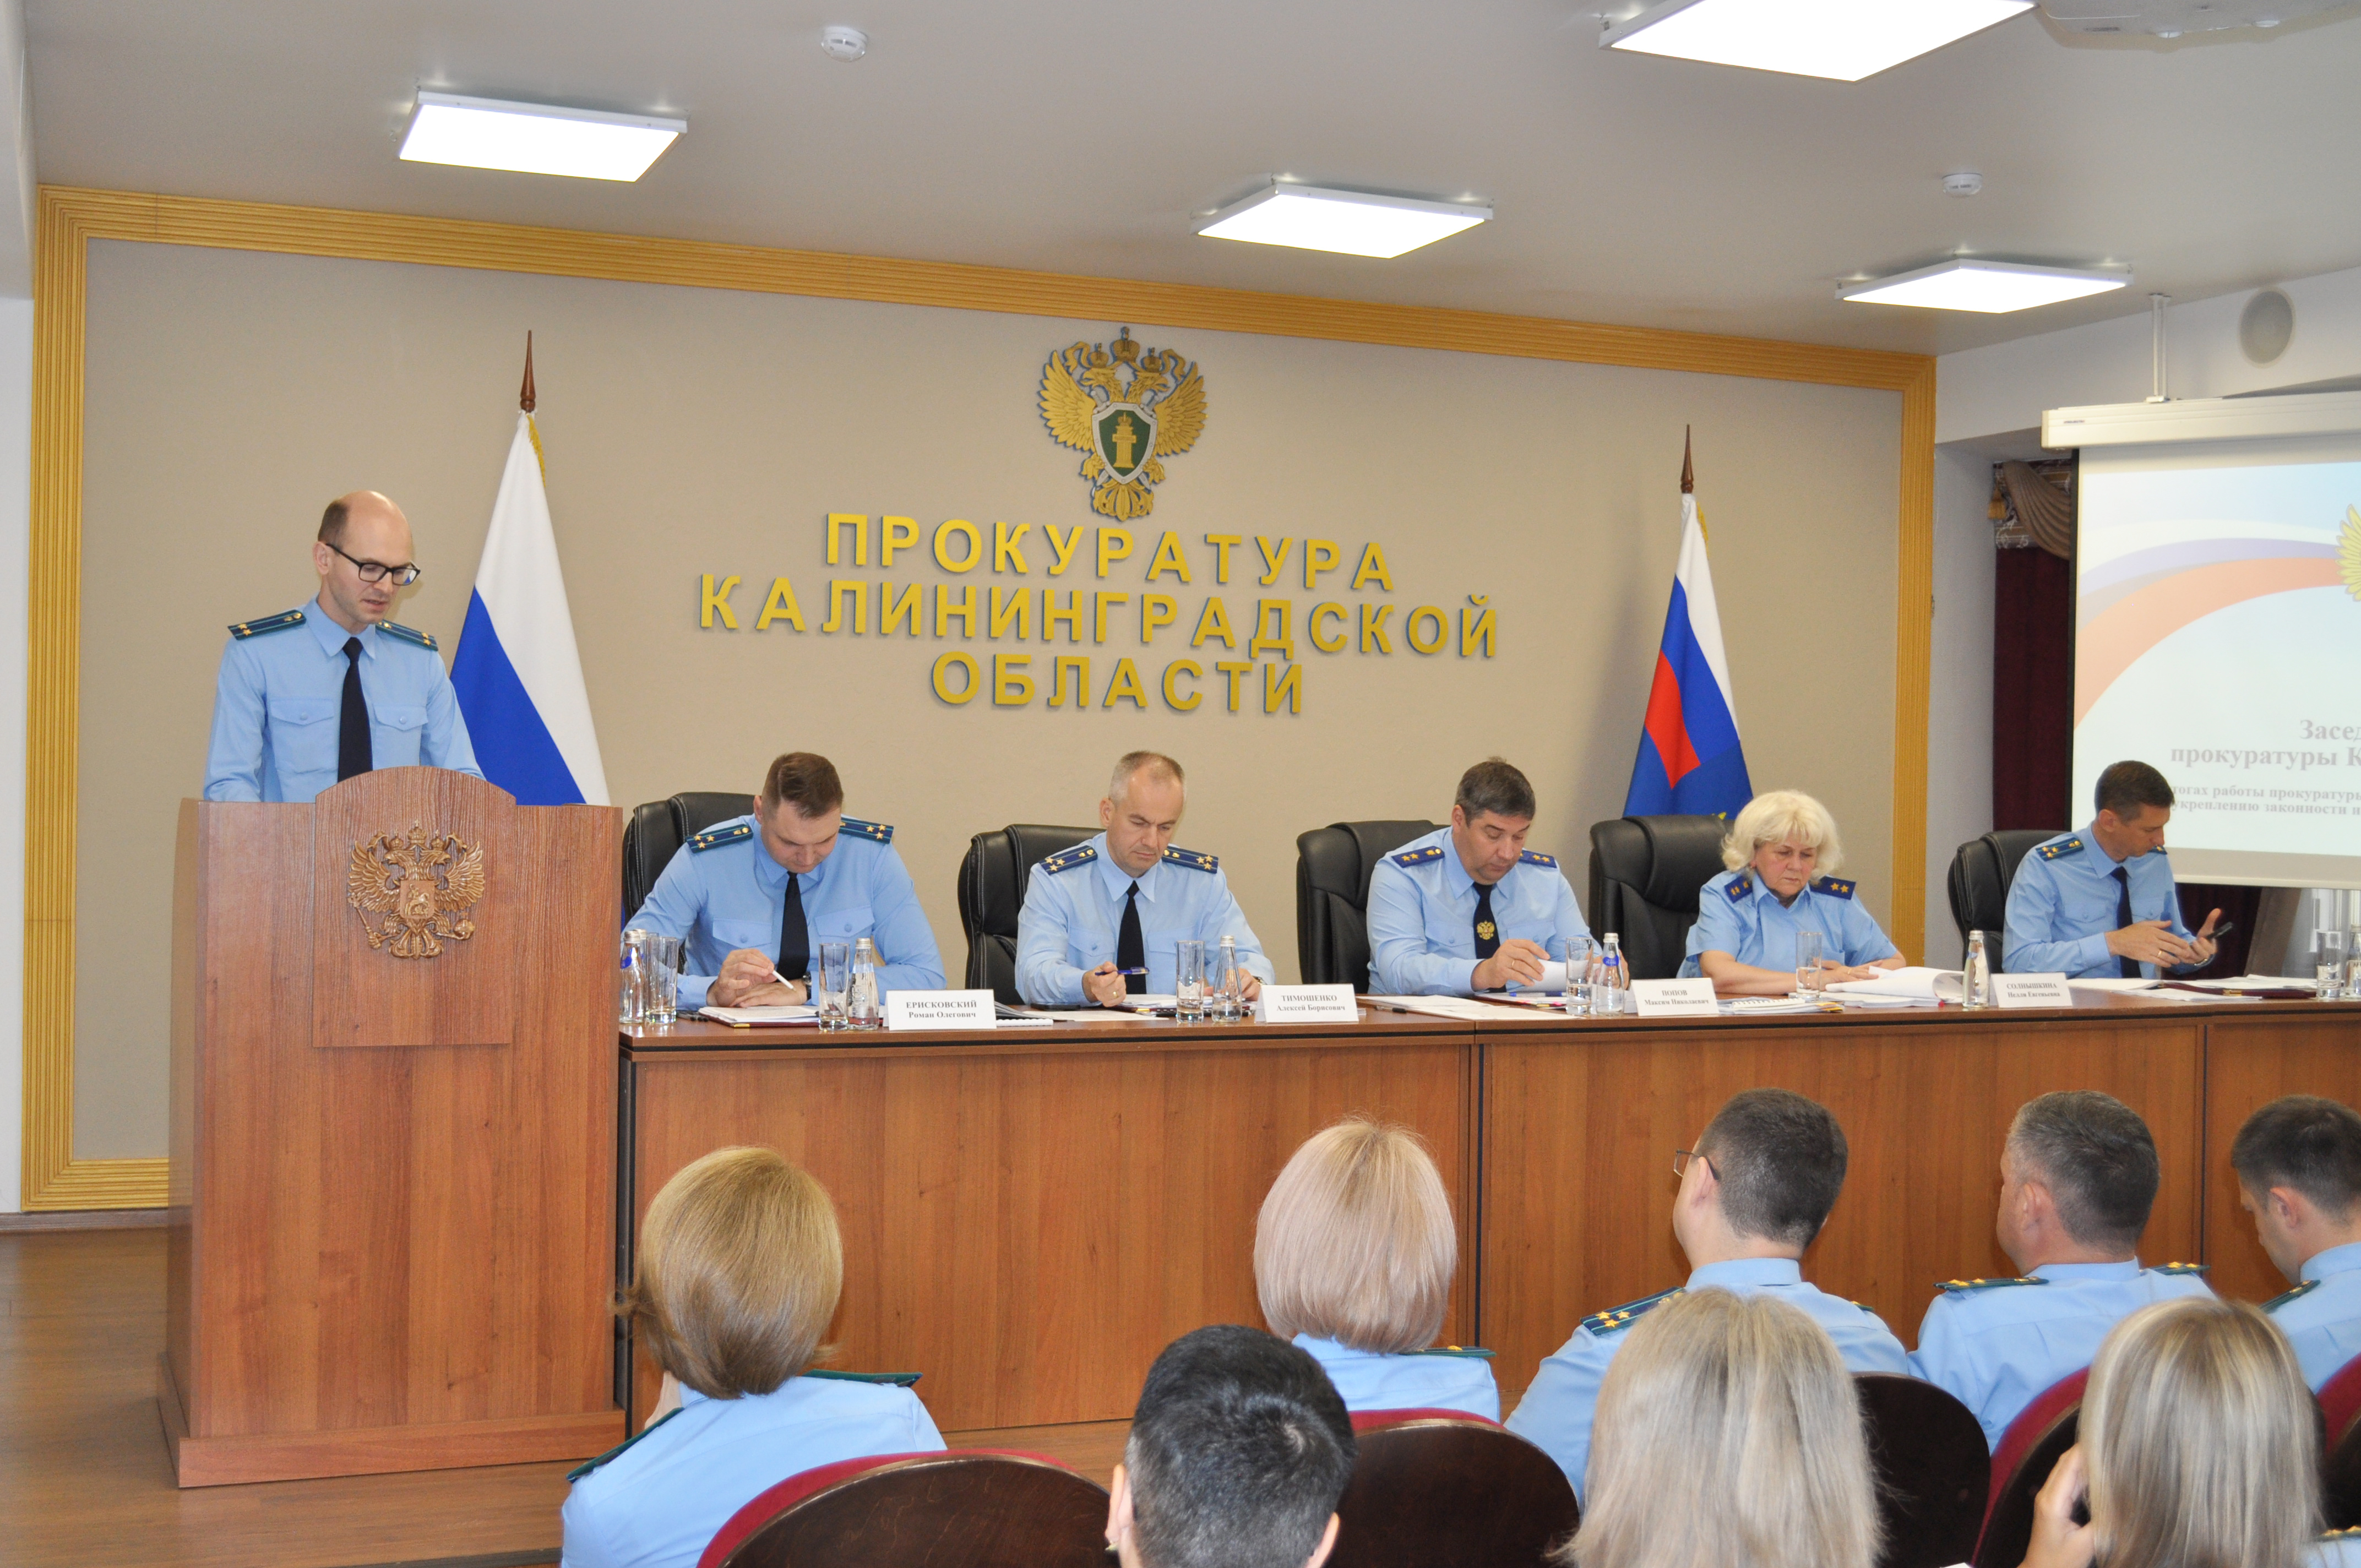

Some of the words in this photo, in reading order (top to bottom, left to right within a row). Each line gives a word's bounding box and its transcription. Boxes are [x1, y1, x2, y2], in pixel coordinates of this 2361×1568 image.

[825, 512, 1394, 592] ПРОКУРАТУРА
[699, 573, 1497, 660] КАЛИНИНГРАДСКОЙ
[932, 650, 1303, 714] ОБЛАСТИ
[2170, 748, 2337, 771] прокуратуры
[2172, 786, 2208, 796] тогах
[2212, 785, 2264, 798] работы
[2264, 803, 2347, 815] законности
[906, 999, 977, 1008] ЕРИСКОВСКИЙ
